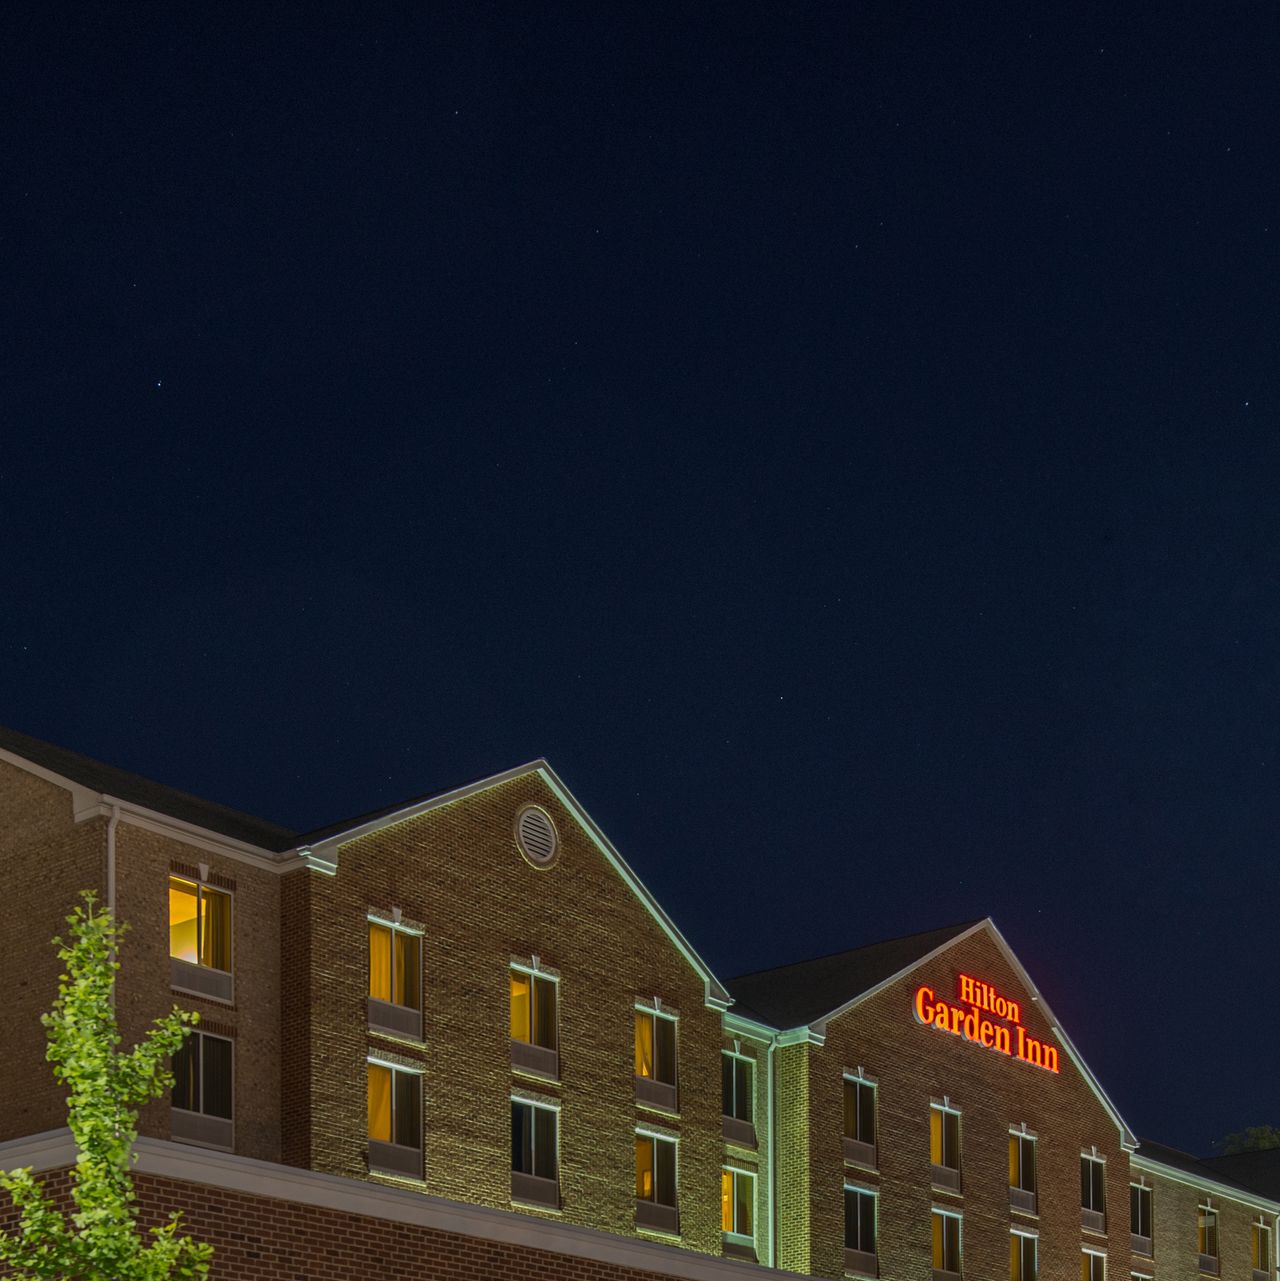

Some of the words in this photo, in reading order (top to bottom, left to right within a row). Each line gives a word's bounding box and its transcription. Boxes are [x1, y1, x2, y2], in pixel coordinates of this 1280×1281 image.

[915, 986, 1011, 1056] Garden
[1016, 1025, 1059, 1074] Inn
[960, 974, 1020, 1023] Hilton
